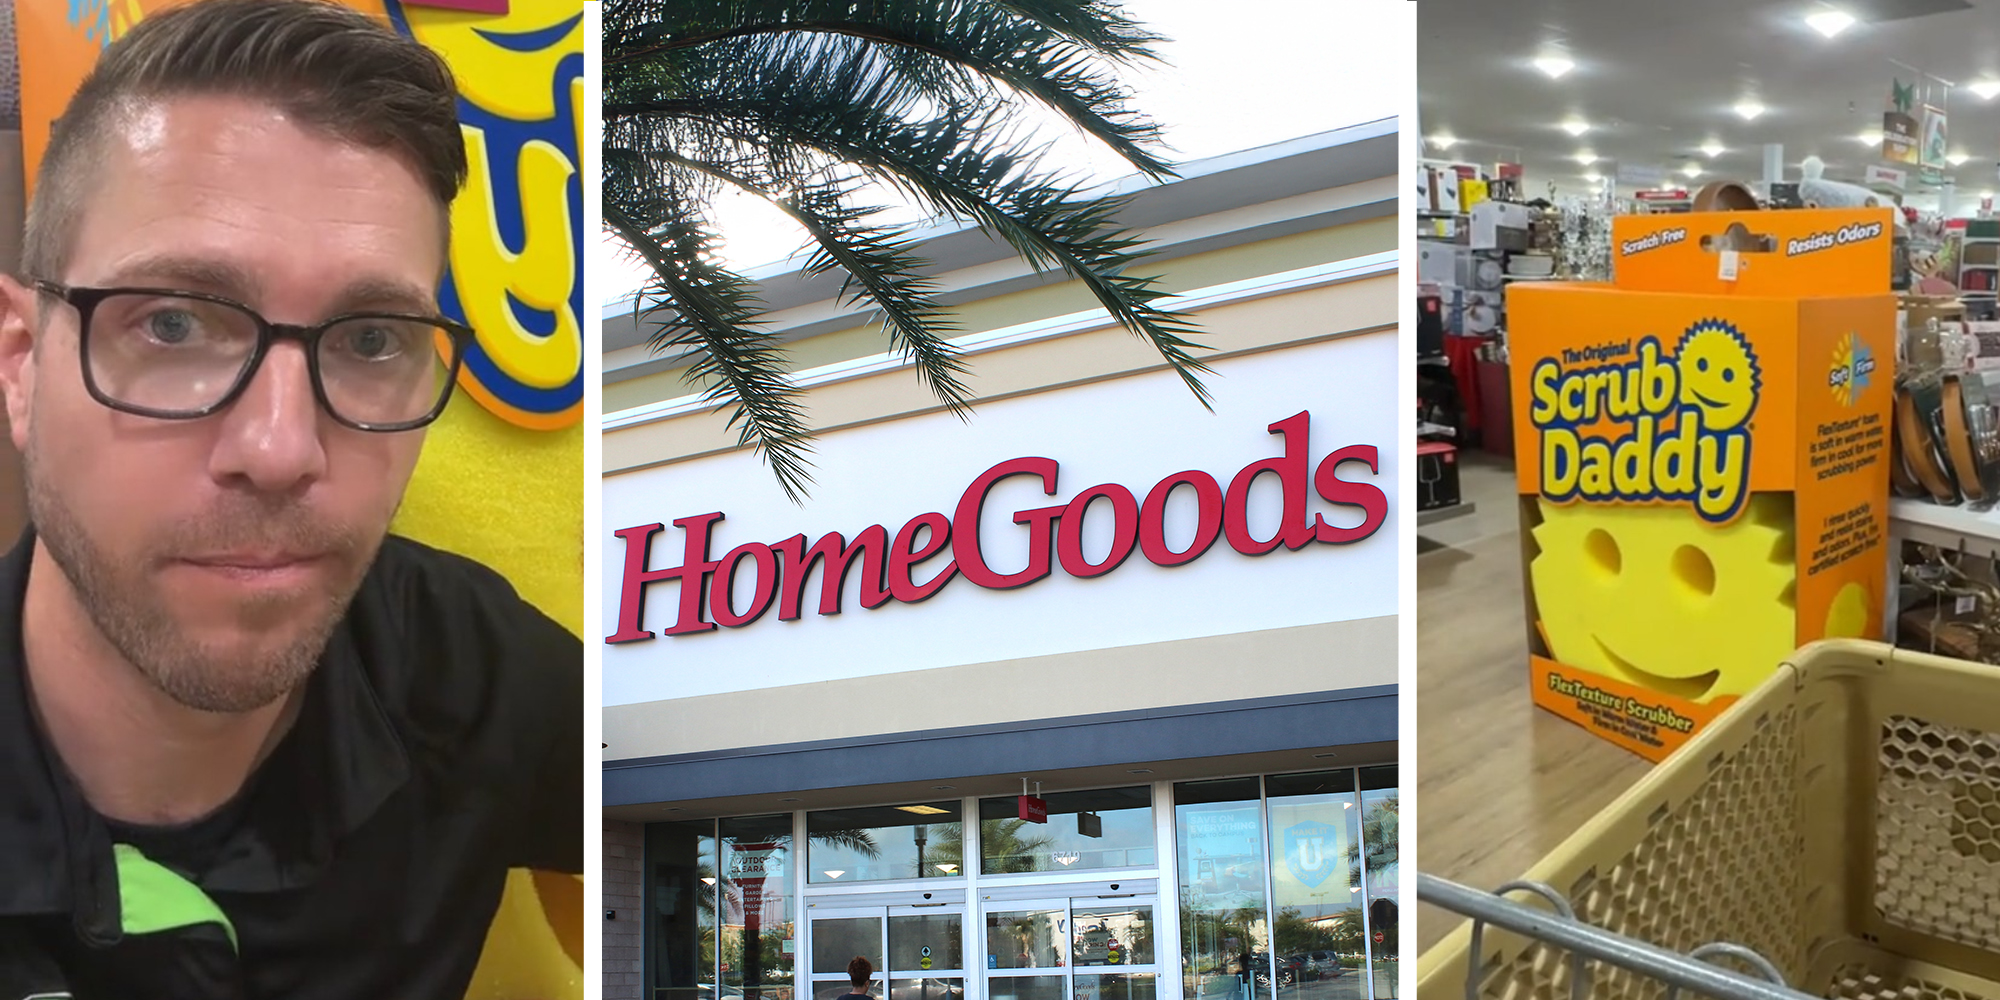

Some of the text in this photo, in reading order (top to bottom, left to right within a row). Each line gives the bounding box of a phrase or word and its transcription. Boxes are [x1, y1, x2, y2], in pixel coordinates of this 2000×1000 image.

[1621, 228, 1686, 256] Scratch Free
[1786, 222, 1882, 256] Resists Odors
[1562, 338, 1632, 365] The Original
[1533, 341, 1676, 424] Scrub
[1830, 366, 1849, 386] Soft
[1542, 410, 1748, 519] Daddy
[1818, 461, 1854, 480] scrubbing
[604, 409, 1390, 644] HomeGoods
[1549, 674, 1693, 732] FlexTexture Scrubber
[1190, 814, 1234, 824] SAVE ON
[1190, 822, 1256, 832] EVERYTHING
[1292, 828, 1318, 836] MAKE
[1296, 836, 1324, 871] U
[731, 864, 781, 873] CLEARANCE
